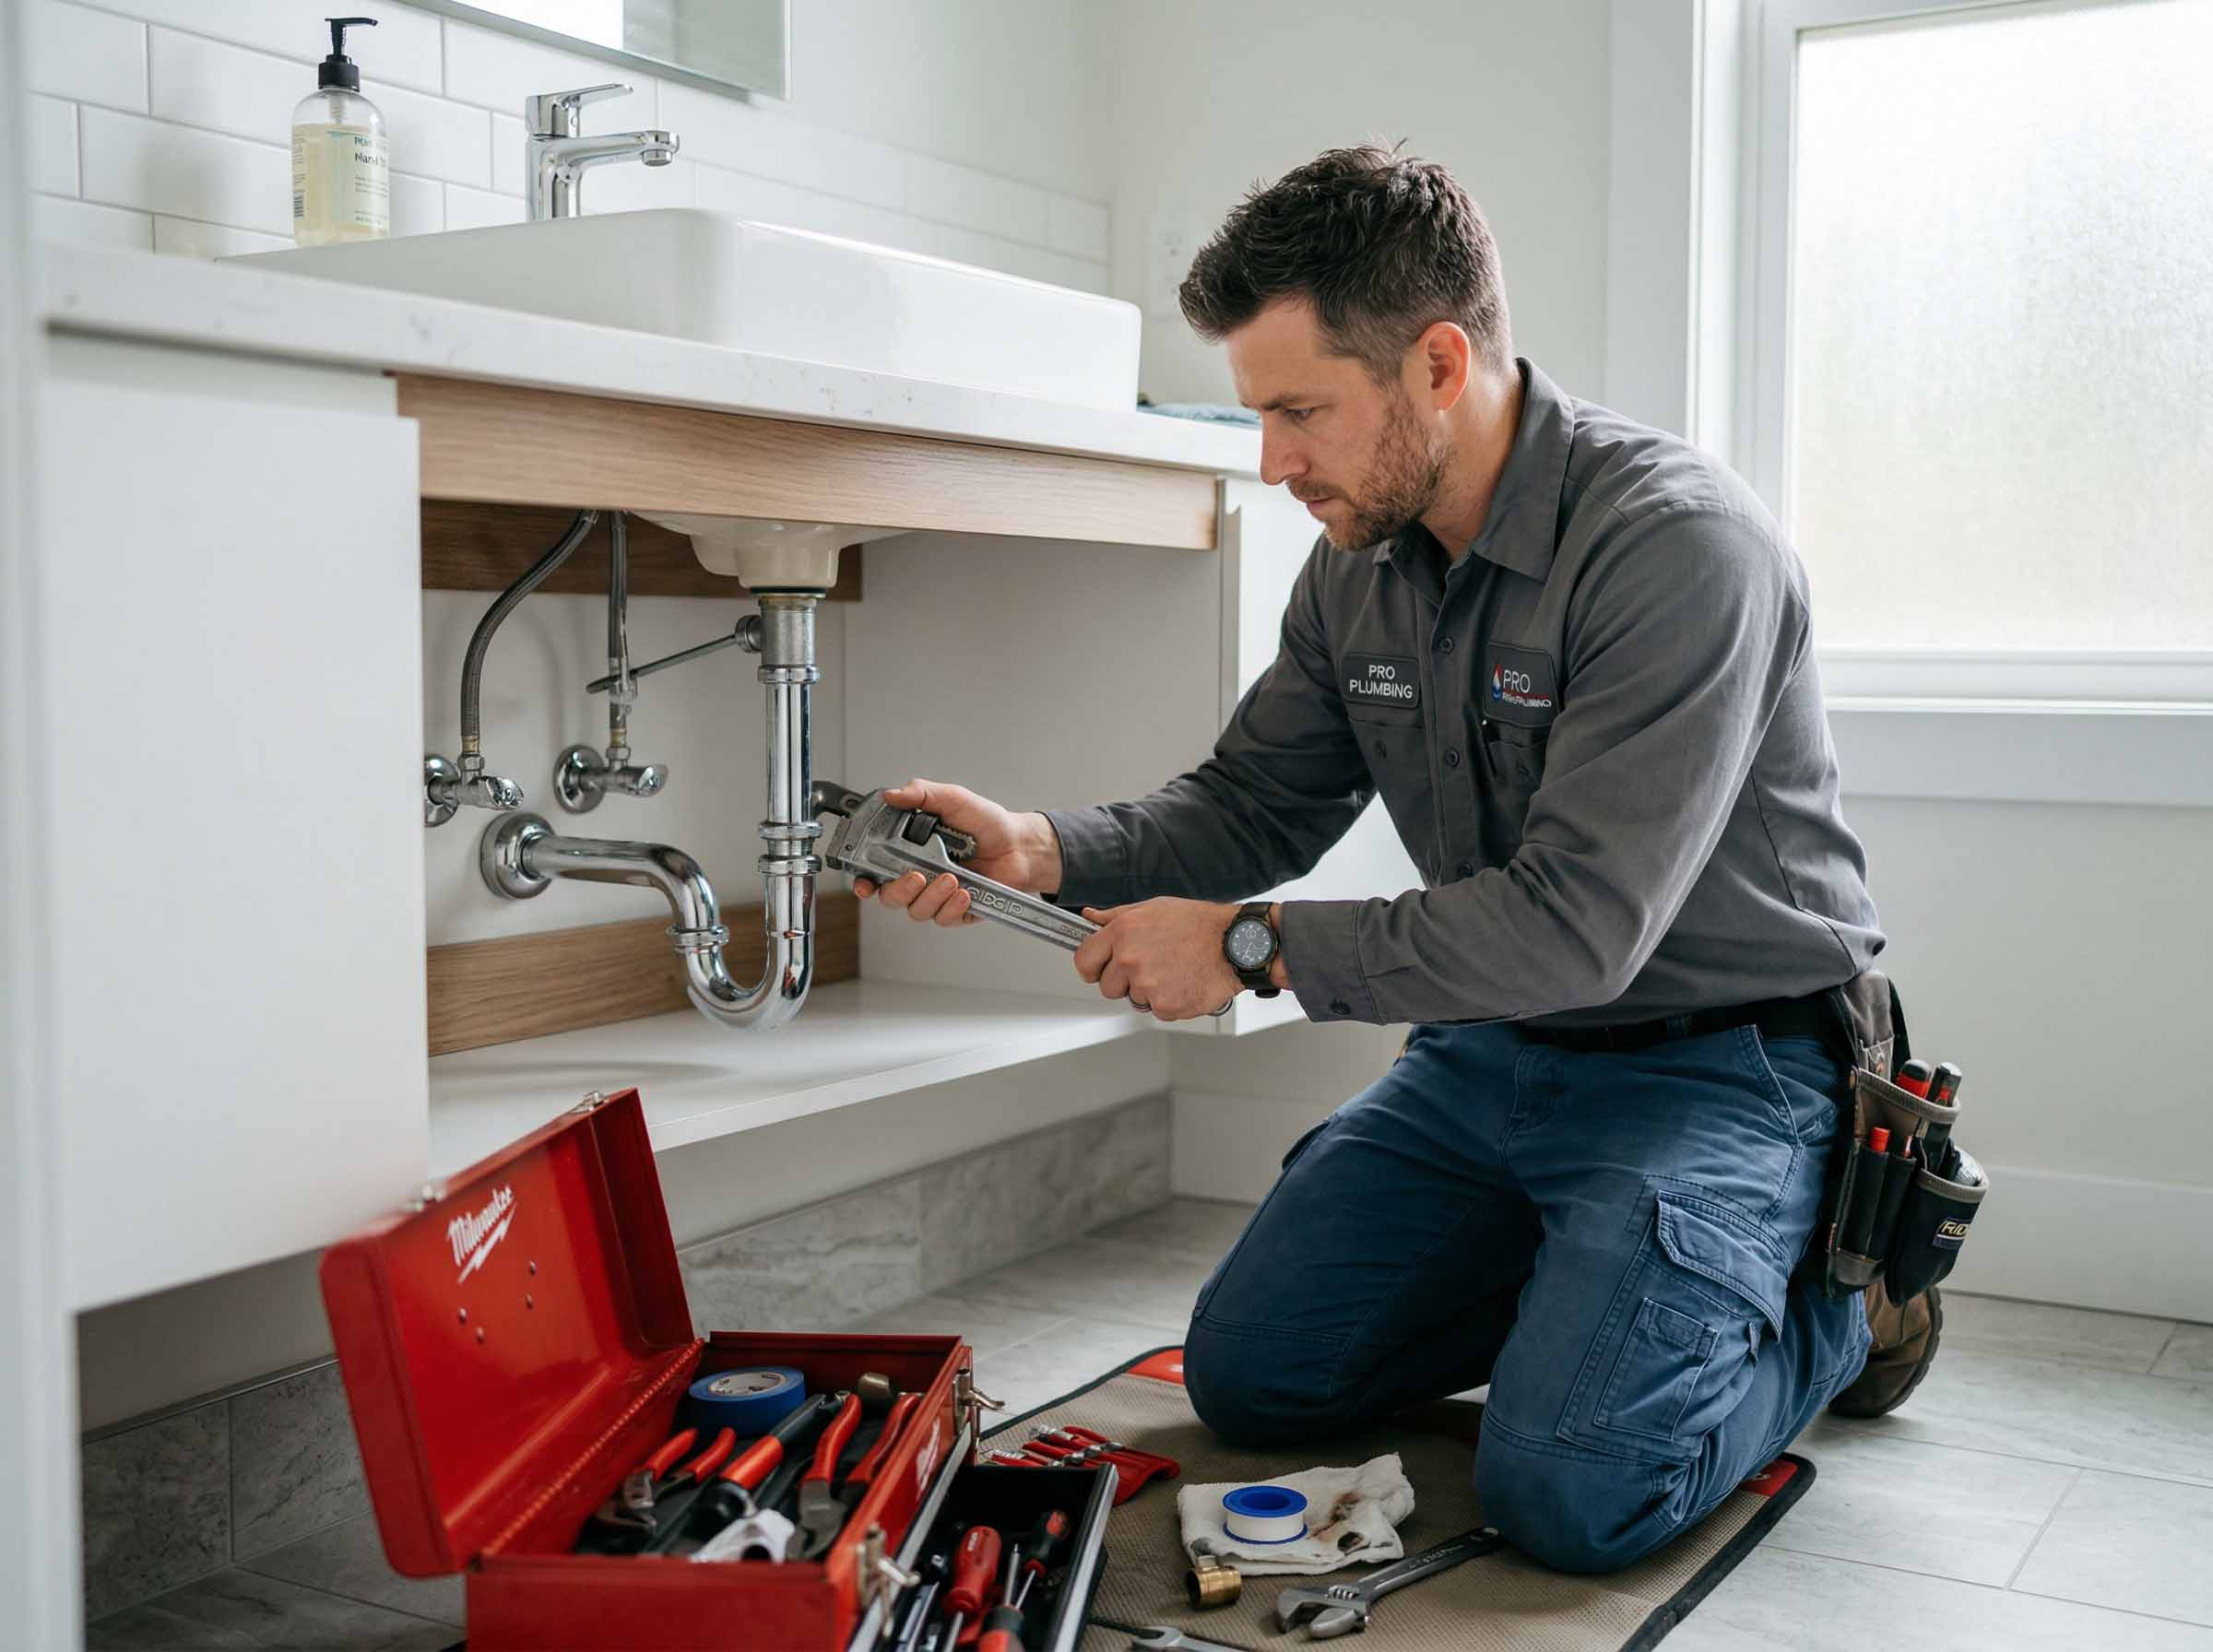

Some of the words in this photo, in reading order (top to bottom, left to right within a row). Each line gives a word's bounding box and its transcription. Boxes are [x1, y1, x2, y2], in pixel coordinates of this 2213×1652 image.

[1368, 665, 1395, 680] PRO
[1503, 669, 1531, 693] PRO
[1349, 679, 1413, 699] PLUMBING
